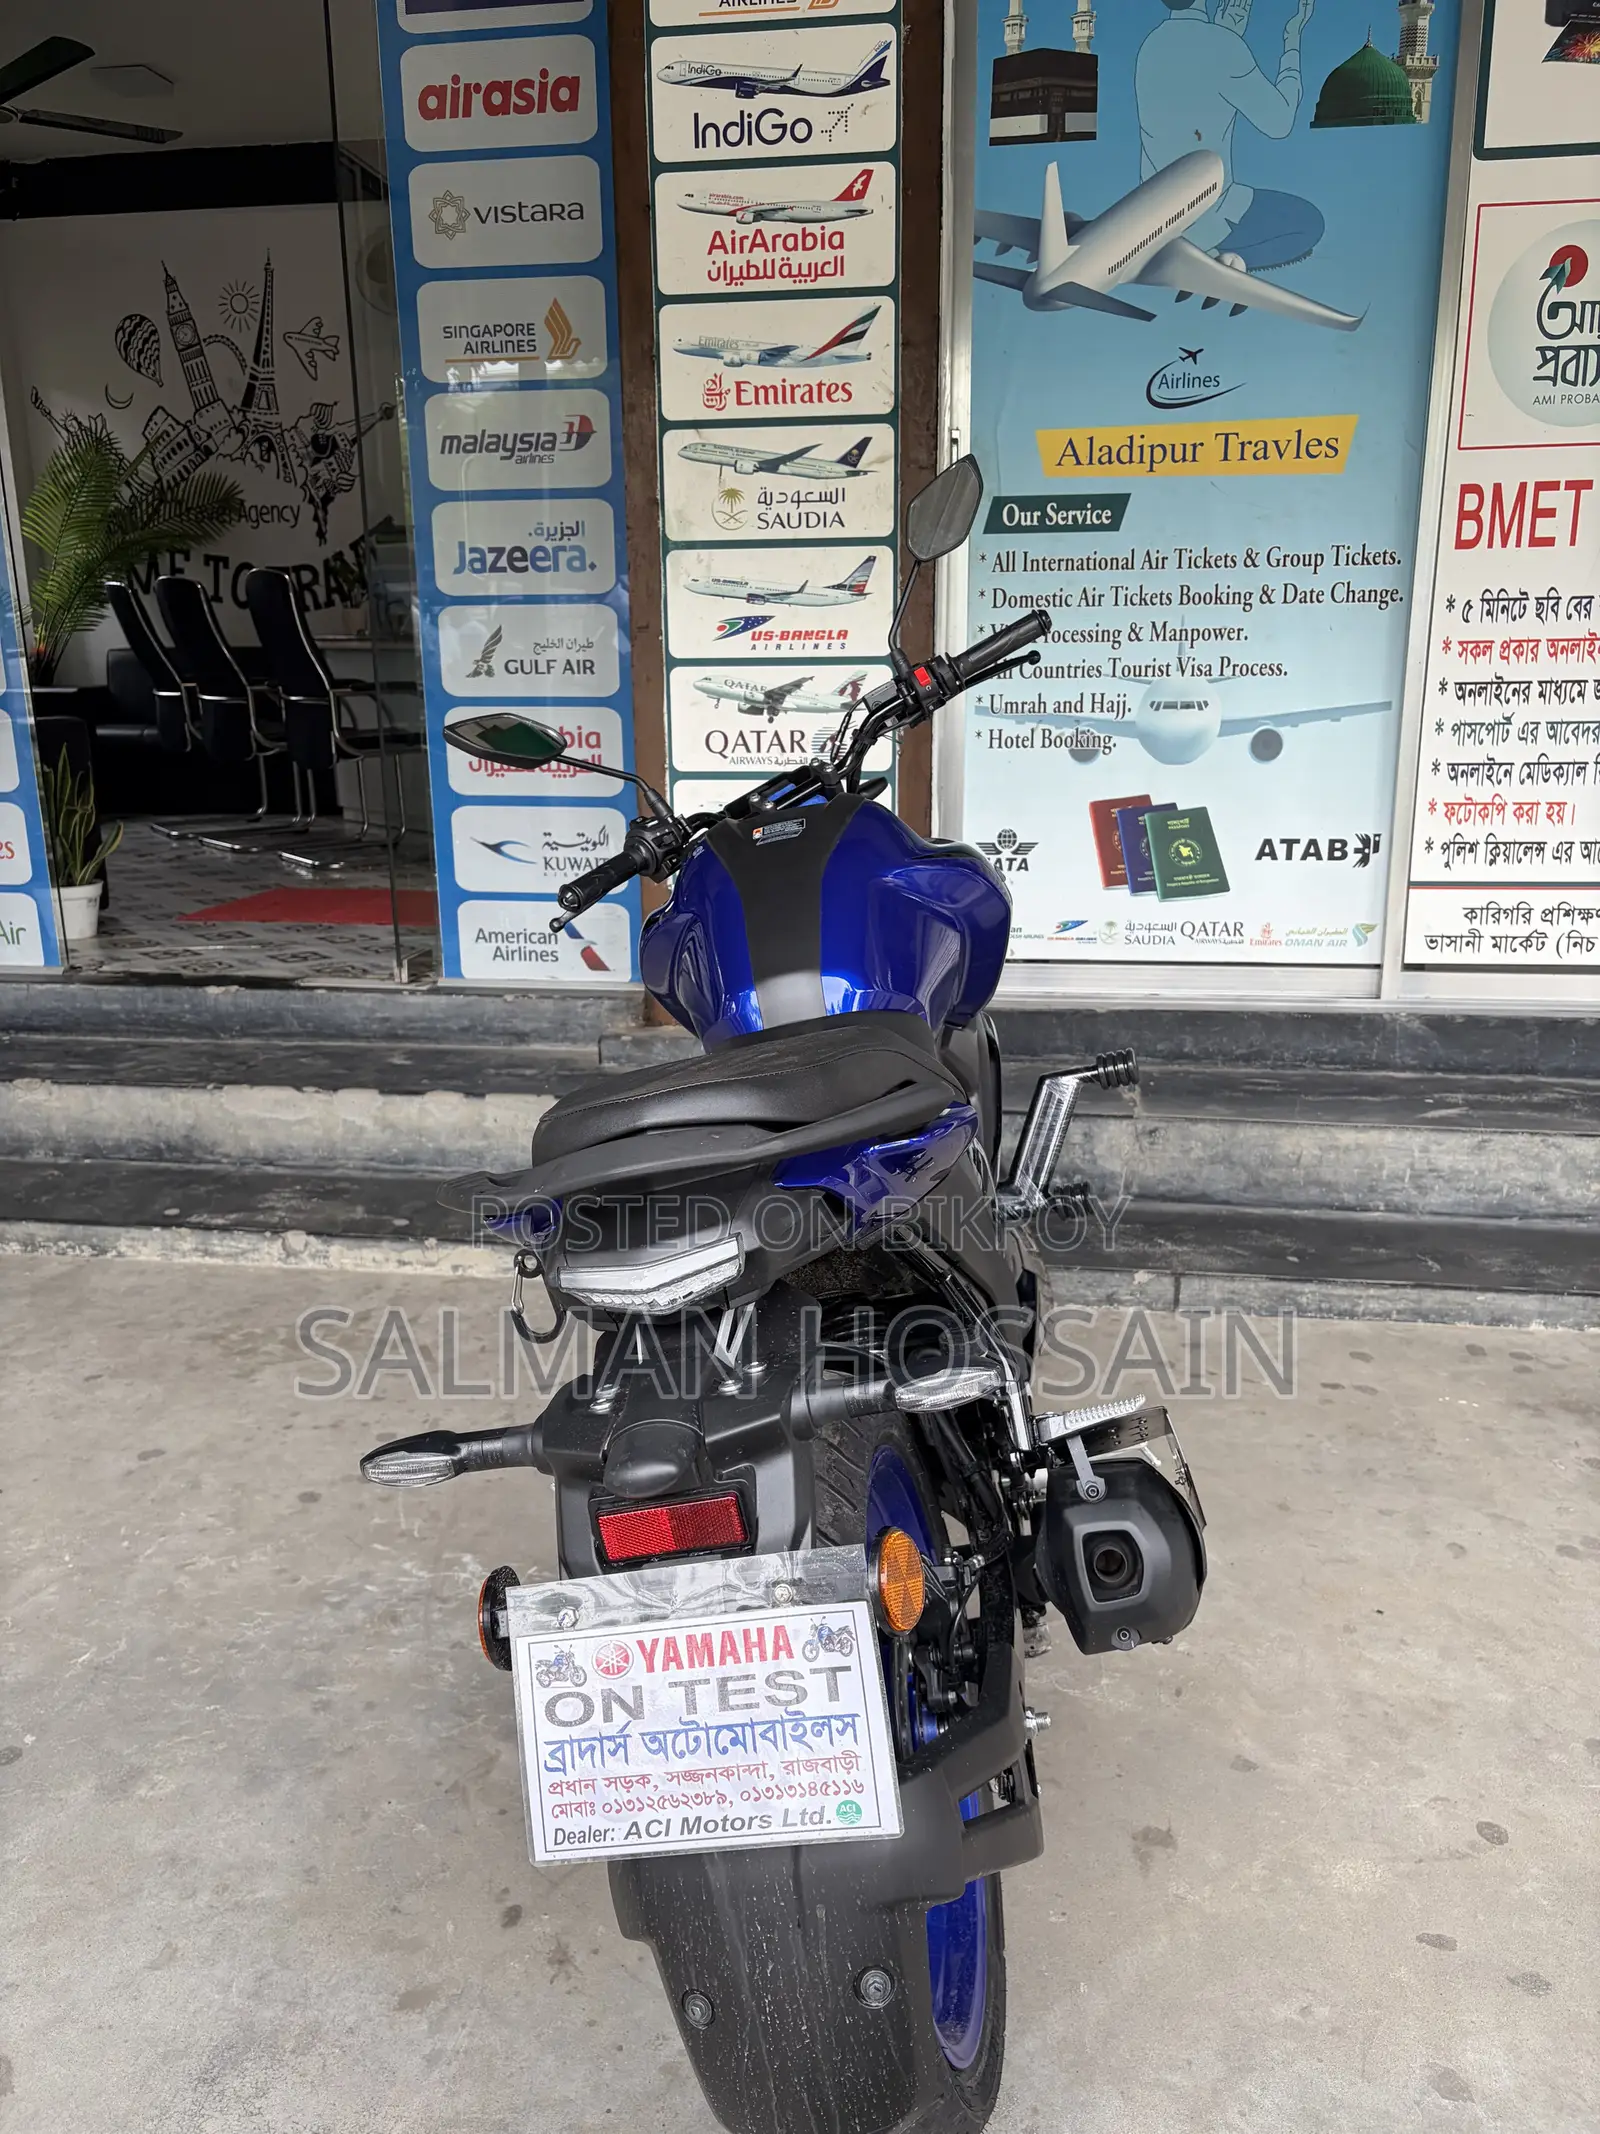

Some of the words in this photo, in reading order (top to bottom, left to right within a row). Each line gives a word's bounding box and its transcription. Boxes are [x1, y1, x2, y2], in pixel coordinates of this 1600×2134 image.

[688, 63, 722, 77] IndiGo
[418, 67, 580, 121] airasia
[693, 108, 813, 149] IndiGo
[707, 225, 845, 255] AirArabia
[707, 257, 775, 286] للطيران
[778, 255, 845, 284] العربية
[442, 323, 536, 340] SINGAPORE
[463, 339, 537, 355] AIRLINES
[734, 378, 853, 406] Emirates
[1158, 371, 1220, 390] Airlines
[1532, 394, 1555, 406] AMI
[440, 429, 557, 461] malaysia
[1055, 434, 1204, 473] Aladipur
[1214, 429, 1340, 462] Travles
[515, 454, 554, 465] airlines
[757, 487, 845, 510] السعودية
[757, 511, 845, 530] SAUDIA
[1002, 503, 1041, 526] Our
[1045, 502, 1112, 525] Service
[1454, 479, 1594, 550] BMET
[991, 550, 1016, 573] All
[1022, 548, 1135, 572] International
[1140, 547, 1168, 570] Air
[1174, 547, 1237, 570] Tickets
[1243, 547, 1260, 568] &
[1266, 546, 1325, 575] Group
[1331, 543, 1402, 567] Tickets.
[991, 587, 1073, 609] Domestic
[1077, 586, 1105, 608] Air
[1110, 584, 1173, 607] Tickets
[1178, 583, 1254, 612] Booking
[1259, 584, 1276, 605] &
[1281, 583, 1325, 605] Date
[1330, 580, 1404, 610] Change.
[1462, 599, 1473, 623] ৫
[1480, 587, 1529, 624] মিনিটে
[1534, 586, 1562, 625] ছবি
[1566, 595, 1595, 622] বের
[533, 638, 564, 654] الخليج
[567, 637, 595, 651] طيران
[751, 629, 848, 641] US-BANGLA
[751, 642, 847, 651] AIRLINES
[1034, 622, 1122, 650] rocessing
[1127, 622, 1143, 643] &
[1149, 621, 1248, 649] Manpower.
[1457, 640, 1495, 665] সকল
[1499, 636, 1541, 665] প্রকার
[1546, 628, 1600, 665] অনলাই
[504, 659, 557, 676] GULF
[562, 659, 597, 675] AIR
[1019, 659, 1102, 680] Countries
[1108, 657, 1171, 678] Tourist
[1176, 656, 1213, 677] Visa
[1218, 656, 1288, 677] Process.
[1454, 671, 1533, 707] অনলাইনের
[1537, 677, 1589, 705] মাধ্যমে
[989, 692, 1047, 715] Umrah
[1053, 692, 1084, 714] and
[1090, 692, 1132, 720] Hajj.
[988, 728, 1035, 749] Hotel
[1041, 728, 1117, 755] Booking.
[1451, 711, 1515, 746] পাসপোর্ট
[1517, 721, 1541, 746] এর
[705, 730, 807, 759] QATAR
[729, 756, 773, 765] AIRWAYS
[1447, 752, 1515, 787] অনলাইনে
[1519, 752, 1589, 787] মেডিক্যাল
[1443, 793, 1508, 826] ফটোকপি
[1513, 800, 1541, 825] করা
[1255, 838, 1348, 861] ATAB
[1552, 841, 1575, 865] এর
[1462, 901, 1534, 926] কারিগরি
[475, 927, 558, 945] American
[1124, 934, 1176, 945] SAUDIA
[1180, 921, 1244, 940] QATAR
[1249, 937, 1283, 947] Emirates
[1285, 938, 1325, 947] OMAN
[1327, 938, 1348, 947] AIR
[1424, 928, 1484, 953] ভাসানী
[1490, 929, 1549, 954] মার্কেট
[492, 945, 559, 963] Airlines
[636, 1624, 794, 1673] YAMAHA
[544, 1685, 645, 1727] ON
[668, 1665, 852, 1716] TEST
[543, 1720, 632, 1776] ব্রাদার্স
[639, 1707, 861, 1762] অটোমোবাইলস
[548, 1777, 598, 1798] প্রধান
[602, 1773, 659, 1794] সড়ক,
[780, 1750, 863, 1777] রাজবাড়ী
[839, 1804, 856, 1813] ACI
[554, 1827, 615, 1846] Dealer:
[623, 1818, 671, 1840] ACI
[680, 1813, 773, 1837] Motors
[782, 1806, 832, 1829] Ltd.
